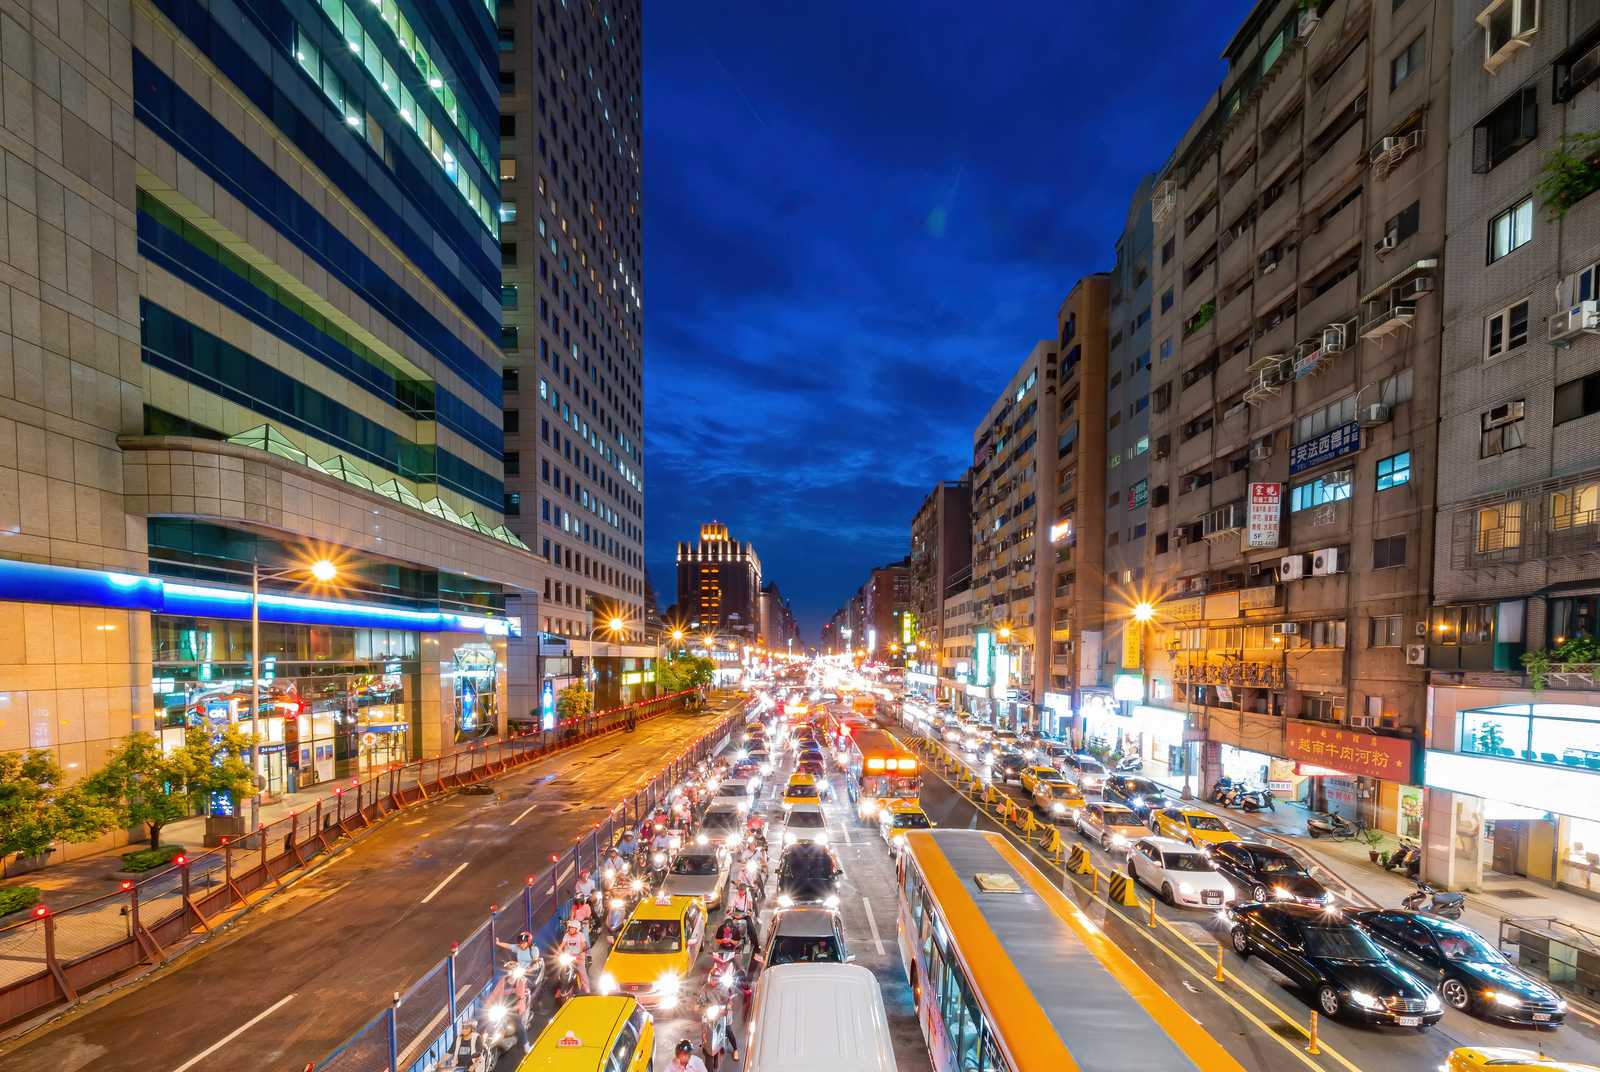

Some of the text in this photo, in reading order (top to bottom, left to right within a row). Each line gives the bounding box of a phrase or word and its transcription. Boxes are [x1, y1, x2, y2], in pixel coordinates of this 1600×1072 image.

[1297, 429, 1343, 464] 英法西德
[1297, 737, 1390, 768] 越南牛肉河粉
